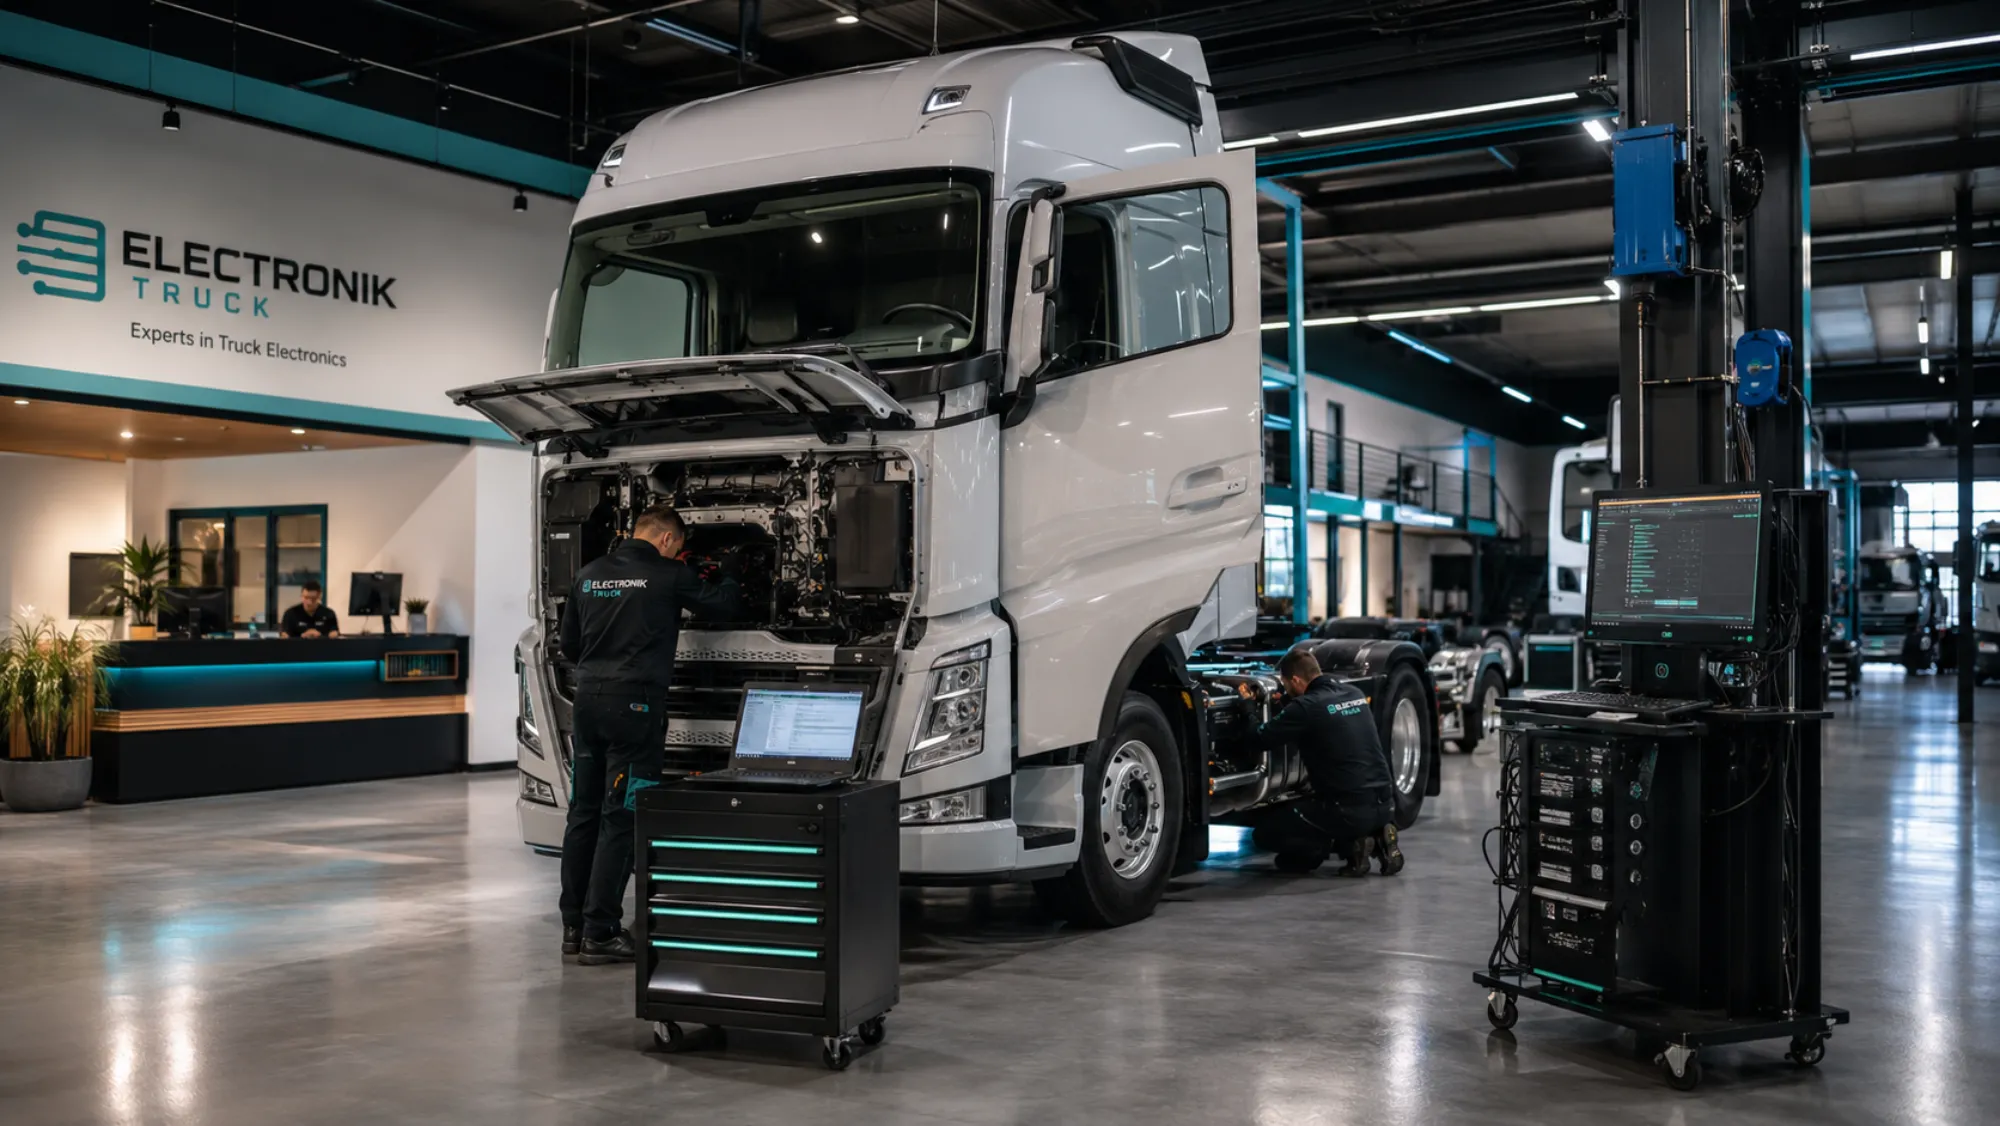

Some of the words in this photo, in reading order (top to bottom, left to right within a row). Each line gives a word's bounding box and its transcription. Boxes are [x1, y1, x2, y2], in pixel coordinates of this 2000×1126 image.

[123, 230, 397, 309] ELECTRONIK
[132, 277, 269, 318] TRUCK
[130, 322, 195, 347] Experts
[199, 332, 214, 349] in
[218, 335, 262, 356] Truck
[266, 342, 347, 368] Electronics
[591, 579, 648, 589] ELECTRONIK
[1334, 698, 1367, 711] ELECTRO
